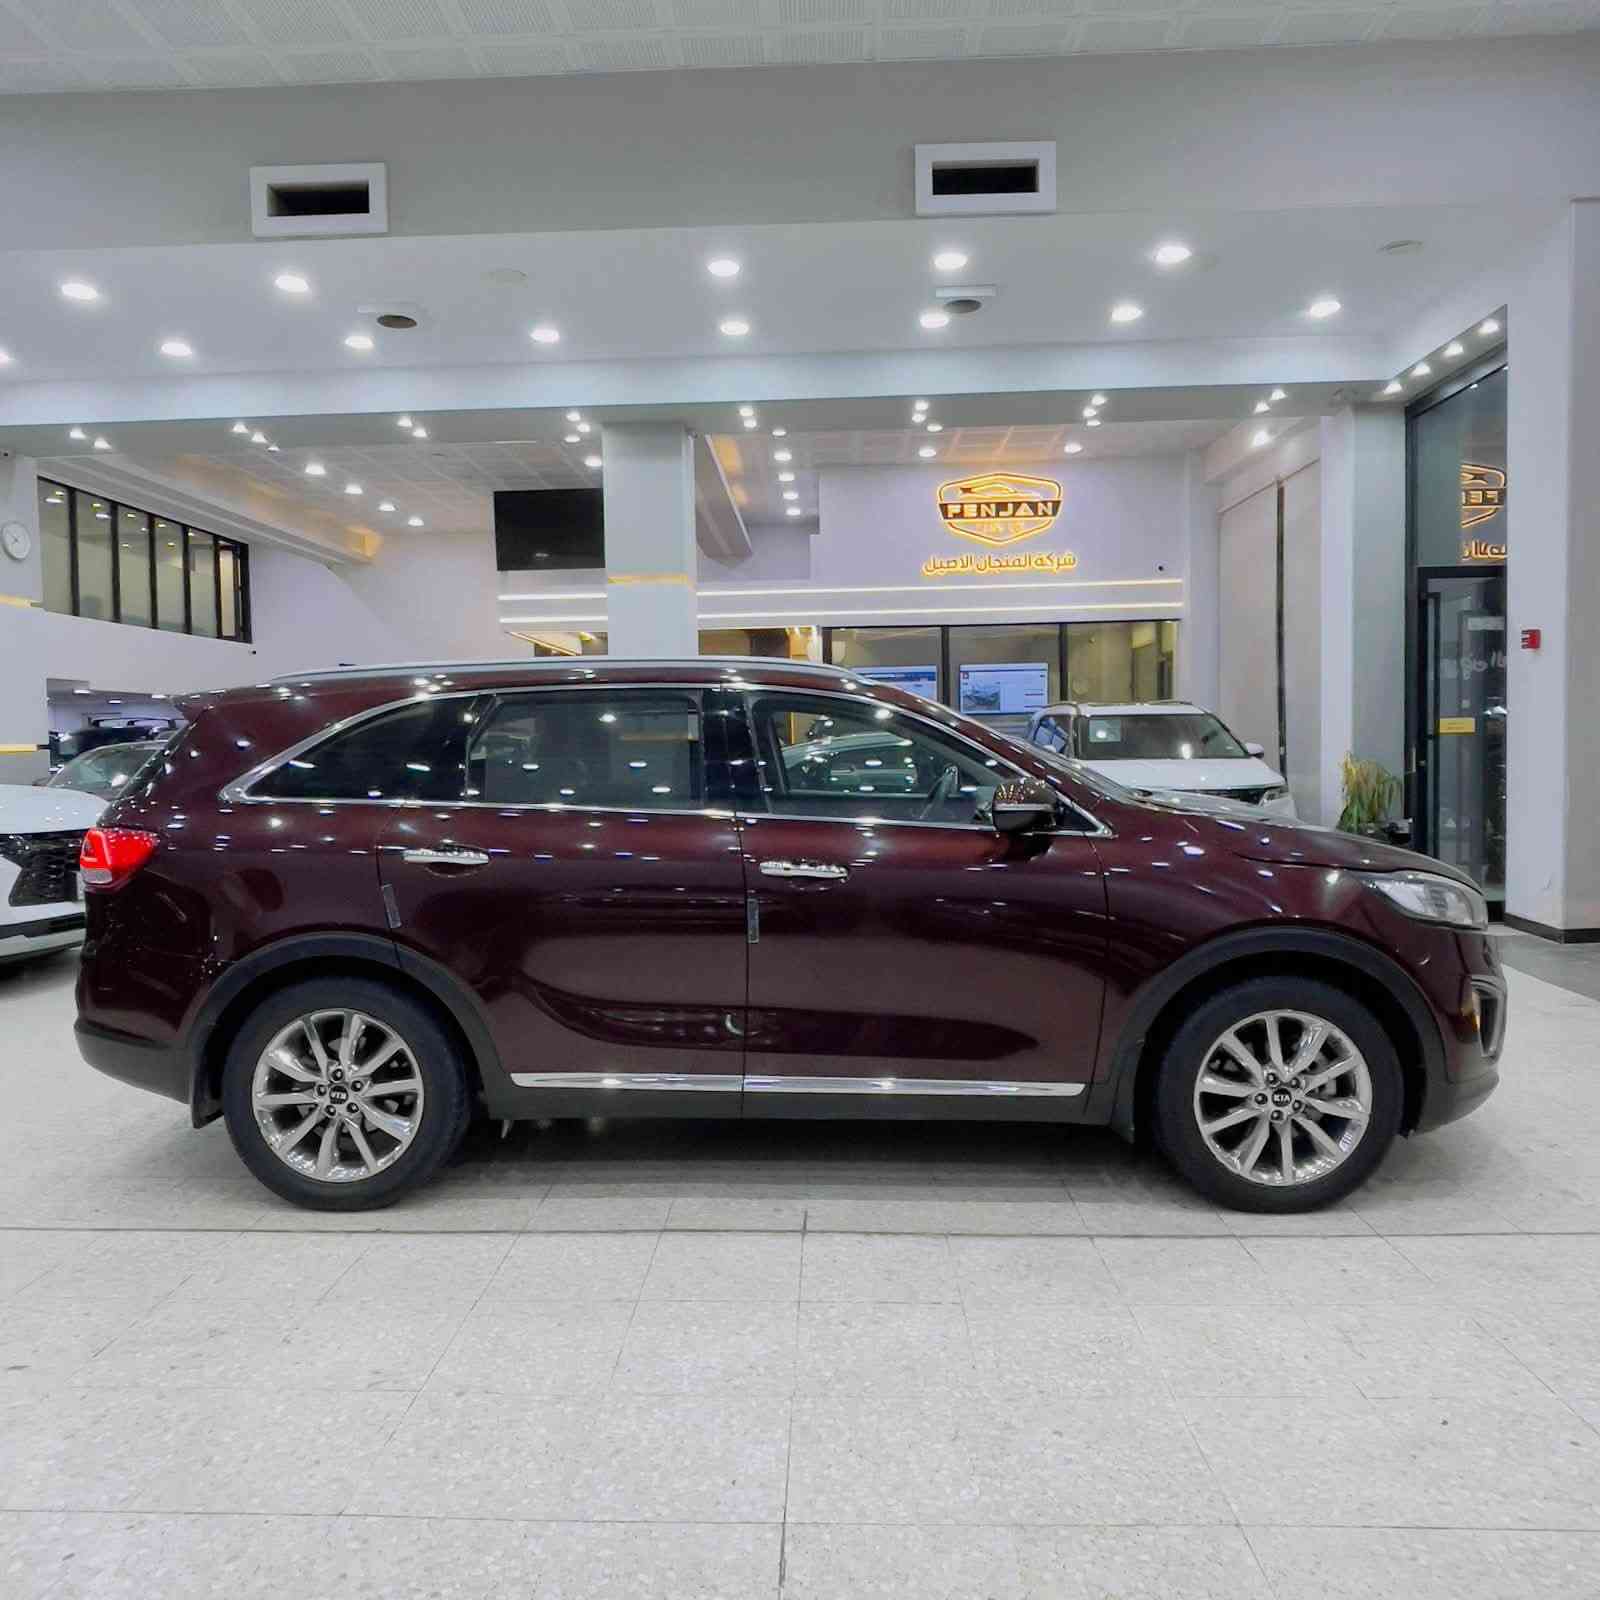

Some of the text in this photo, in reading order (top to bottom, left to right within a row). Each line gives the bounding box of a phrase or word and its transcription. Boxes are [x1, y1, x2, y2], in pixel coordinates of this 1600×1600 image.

[947, 501, 1053, 518] FENJAN
[975, 553, 1032, 574] الفنجان
[1273, 1094, 1291, 1103] KIA
